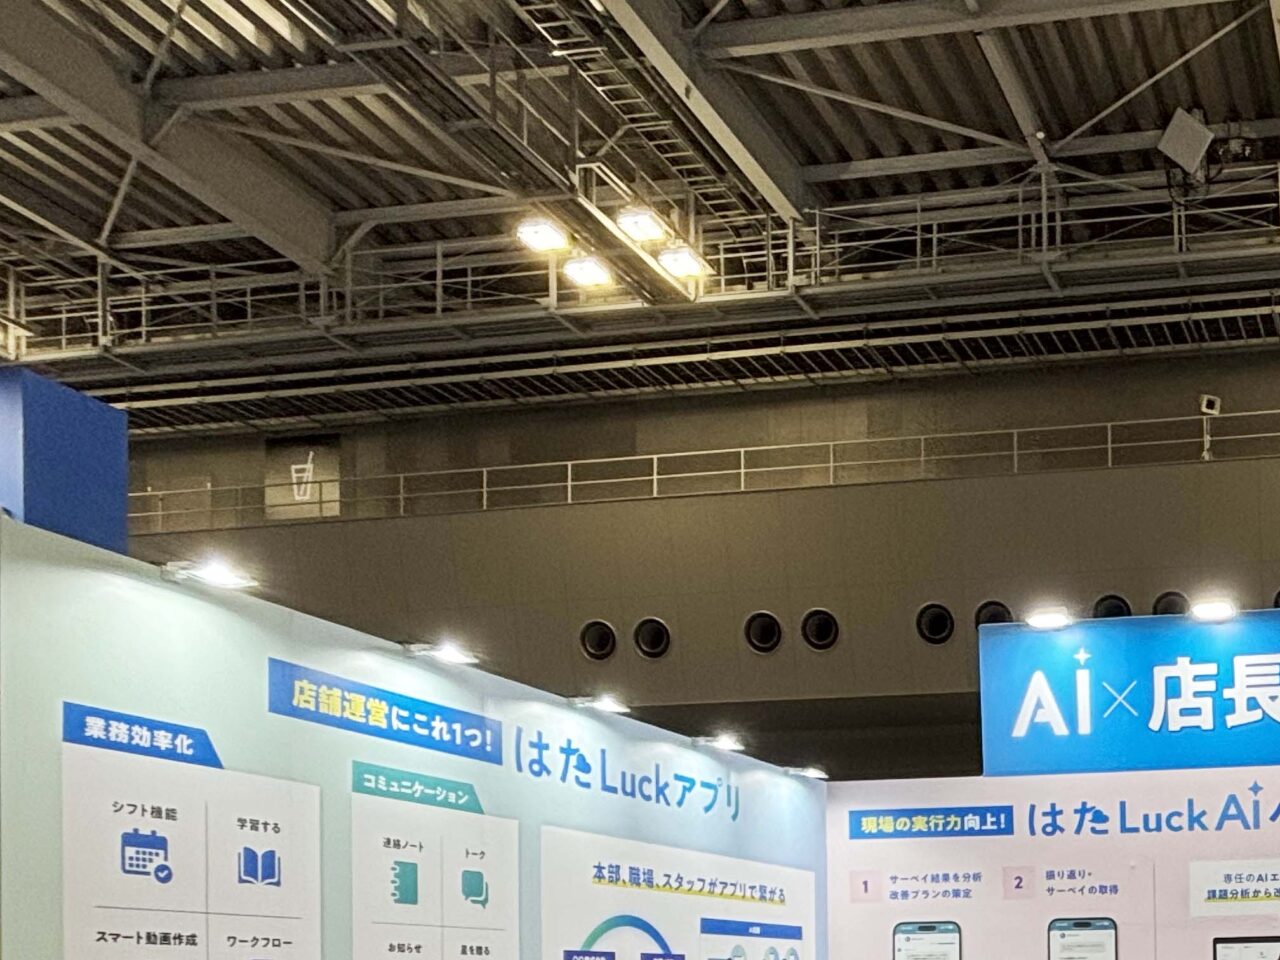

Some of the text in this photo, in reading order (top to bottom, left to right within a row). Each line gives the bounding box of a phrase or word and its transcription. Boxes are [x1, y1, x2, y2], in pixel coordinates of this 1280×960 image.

[83, 716, 195, 757] 業務効率化
[363, 773, 470, 804] コミュニケーション
[112, 801, 178, 822] シフト機能
[236, 817, 282, 834] 学習する
[860, 810, 1006, 833] 現場の実行力向上!
[465, 848, 486, 860] トーク
[889, 872, 983, 884] サーベイ結果を分析
[1014, 876, 1023, 890] 2
[862, 880, 869, 894] 1
[1046, 885, 1119, 896] サーベイの取得
[95, 930, 198, 947] スマート動画作成
[227, 936, 293, 948] ワークフロー
[388, 943, 422, 953] お知らせ
